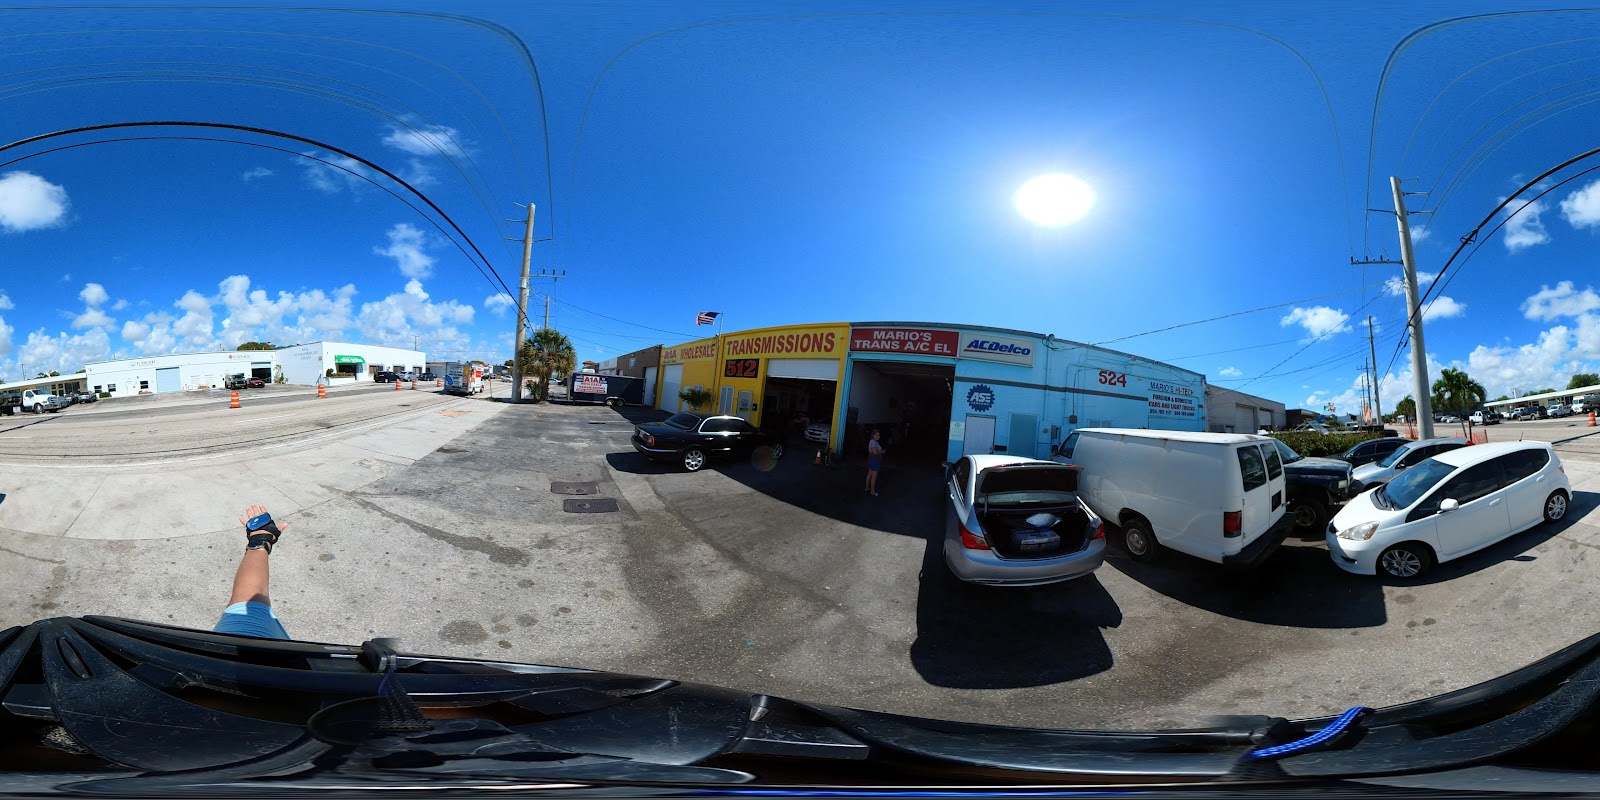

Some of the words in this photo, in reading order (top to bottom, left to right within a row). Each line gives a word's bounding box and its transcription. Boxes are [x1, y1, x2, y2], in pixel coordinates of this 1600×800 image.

[727, 332, 835, 354] TRANSMISSIONS
[873, 330, 932, 341] MARIO'S
[680, 344, 715, 360] WHOLESALE
[855, 339, 900, 350] TRANS
[904, 341, 930, 351] A/C
[934, 343, 951, 353] EL
[966, 339, 1031, 356] ACDelco
[726, 360, 757, 377] 512
[1098, 370, 1126, 387] 524
[970, 392, 991, 402] ASE
[1150, 382, 1174, 392] MARIO'S
[1175, 387, 1194, 396] HI-TECH
